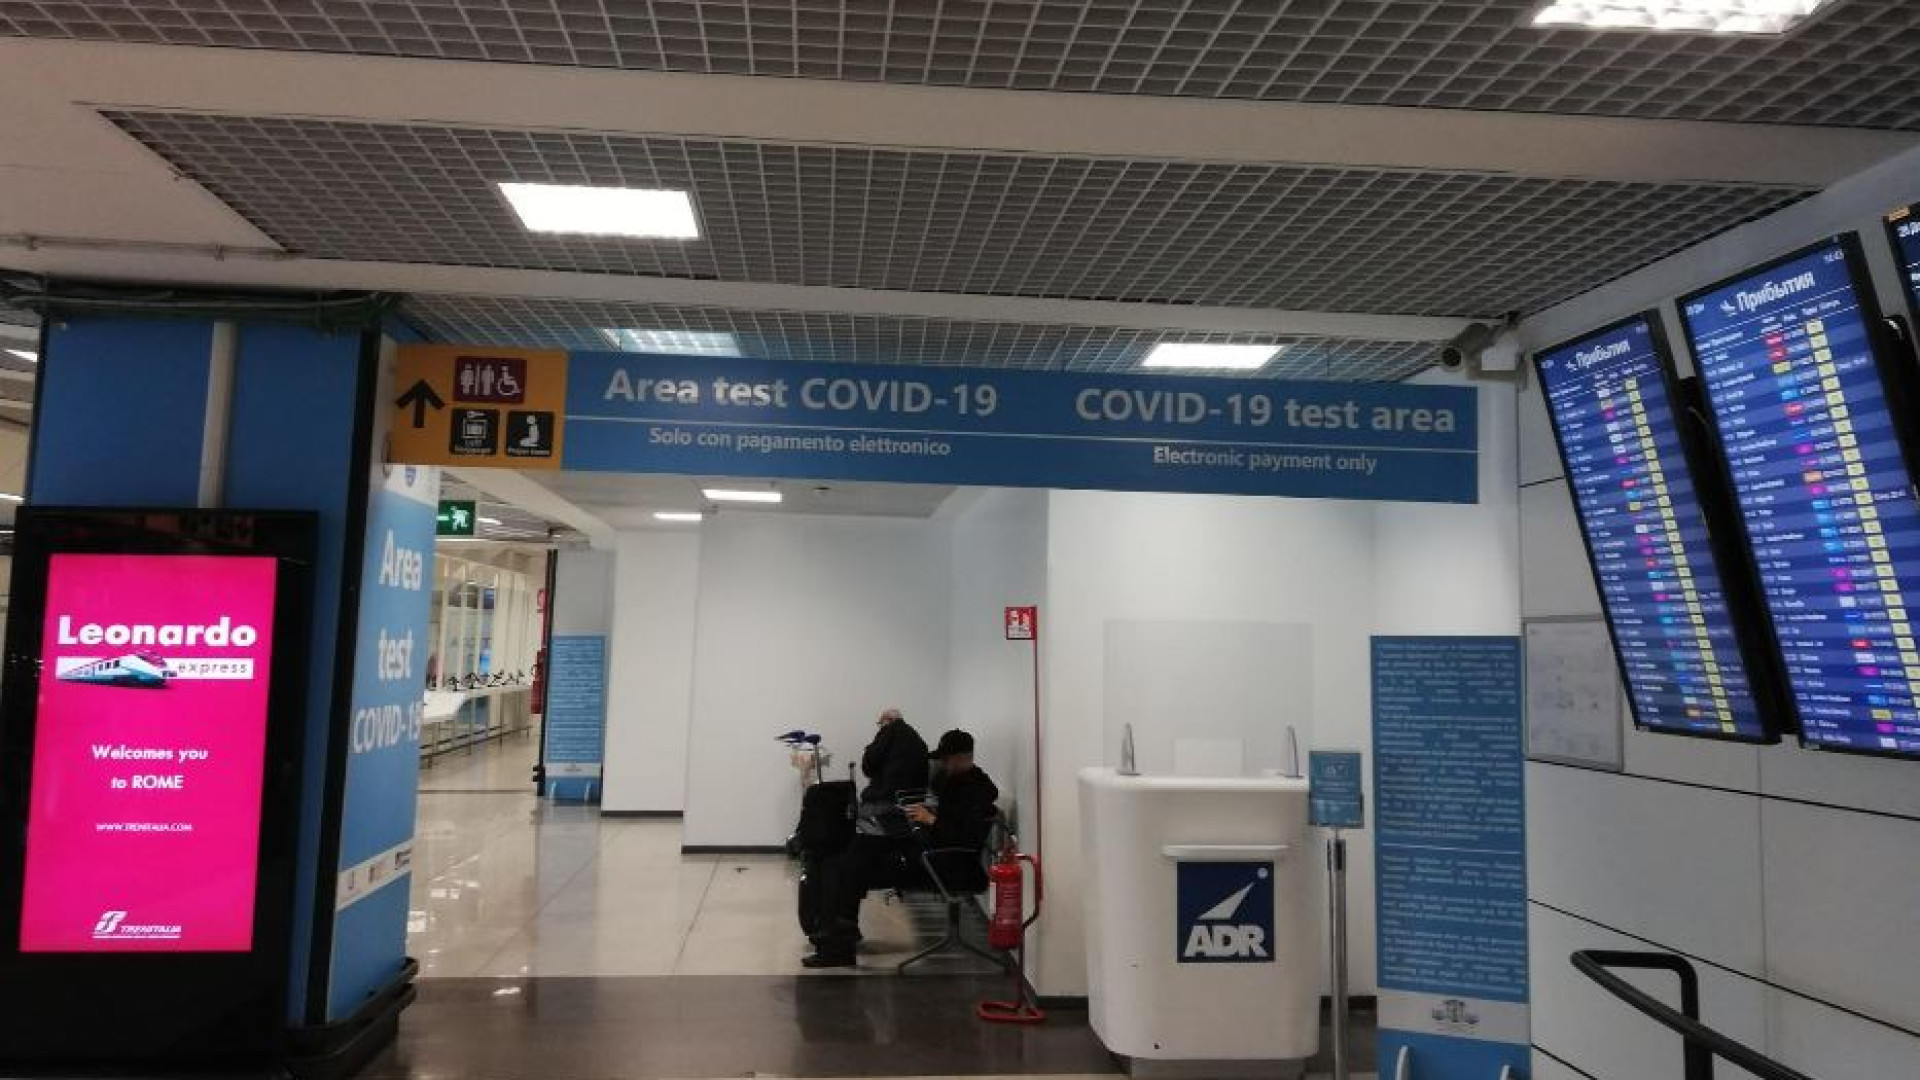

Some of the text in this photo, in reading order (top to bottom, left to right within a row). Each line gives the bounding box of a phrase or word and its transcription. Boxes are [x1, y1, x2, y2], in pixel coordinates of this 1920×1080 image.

[1736, 271, 1815, 311] Прибытия
[604, 367, 997, 416] Area test COVID-19
[1075, 388, 1456, 432] COVID-19 test area
[648, 427, 951, 456] Solo con pagamento elettronico
[1153, 446, 1378, 475] Electronic payment only
[378, 528, 423, 591] Area
[57, 614, 257, 647] Leonardo
[177, 662, 248, 676] express
[378, 626, 414, 680] test
[353, 700, 422, 753] COVID-19
[91, 744, 208, 763] Welcomes you
[111, 774, 184, 789] to ROME
[1184, 924, 1268, 957] ADR
